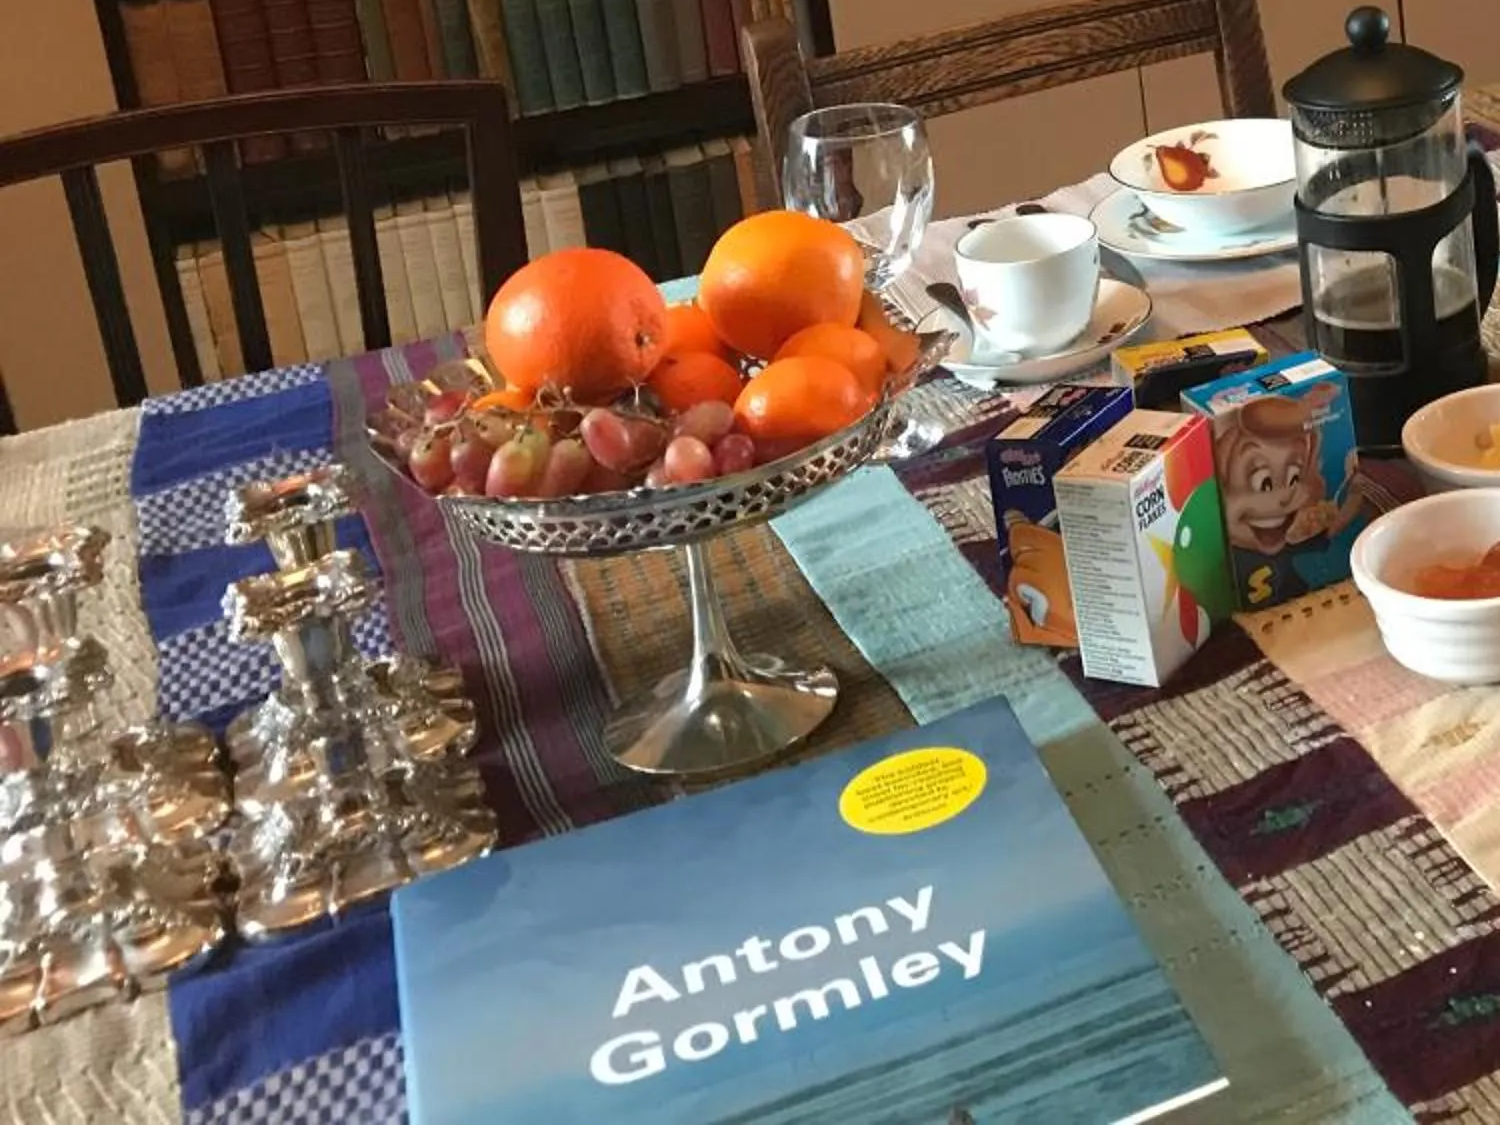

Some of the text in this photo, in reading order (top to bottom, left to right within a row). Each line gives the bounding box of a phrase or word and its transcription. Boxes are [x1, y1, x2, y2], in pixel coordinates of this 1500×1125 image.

[1135, 486, 1166, 518] CORN
[589, 930, 986, 1085] Gormley
[611, 884, 935, 1018] Antony
